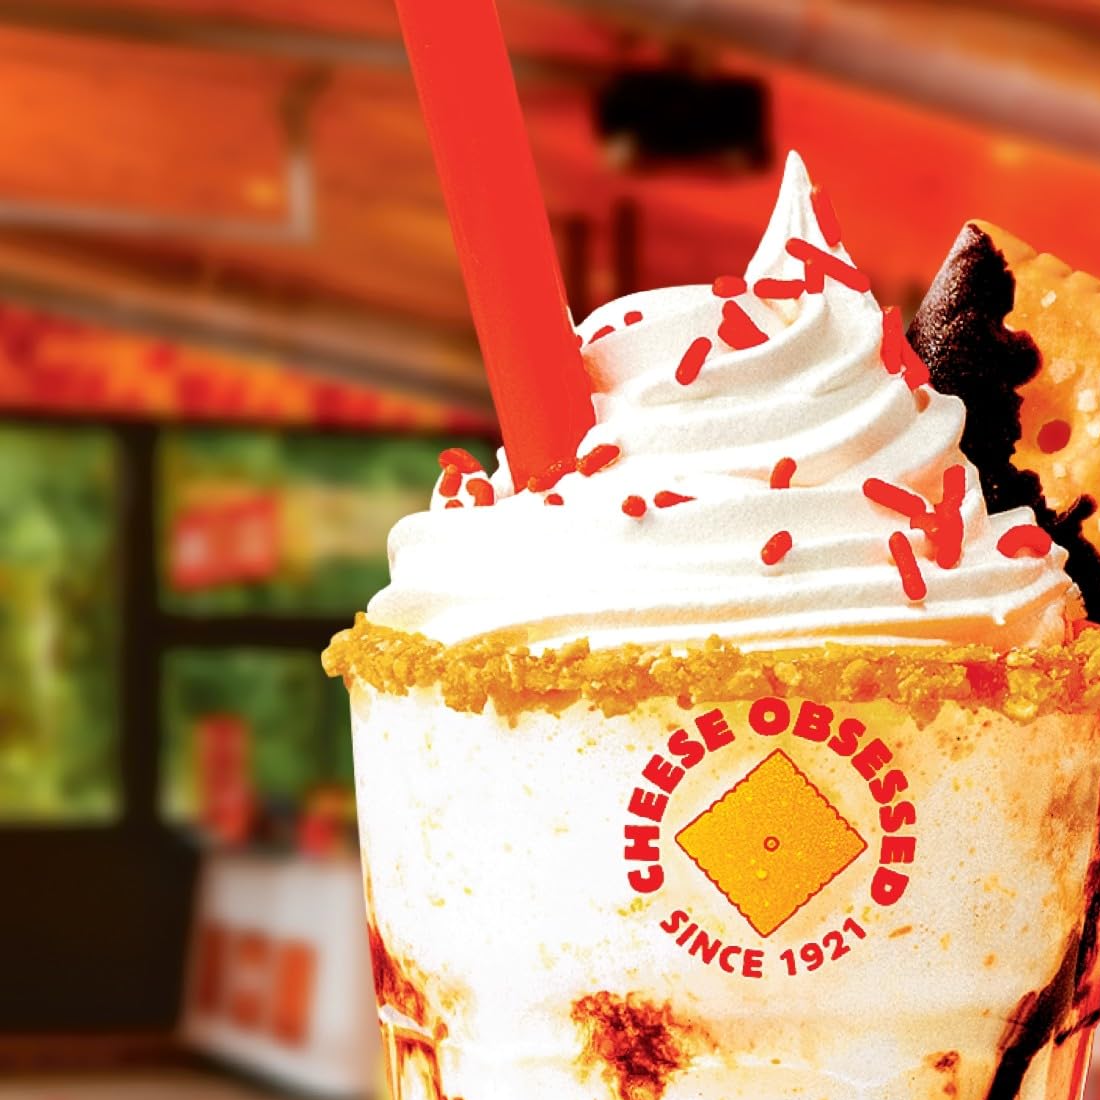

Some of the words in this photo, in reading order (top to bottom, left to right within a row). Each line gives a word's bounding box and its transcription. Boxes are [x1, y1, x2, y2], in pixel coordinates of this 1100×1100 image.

[624, 708, 736, 893] CHEESE
[748, 696, 917, 905] OBSESSED
[659, 910, 763, 978] SINCE
[780, 917, 867, 976] 1921
